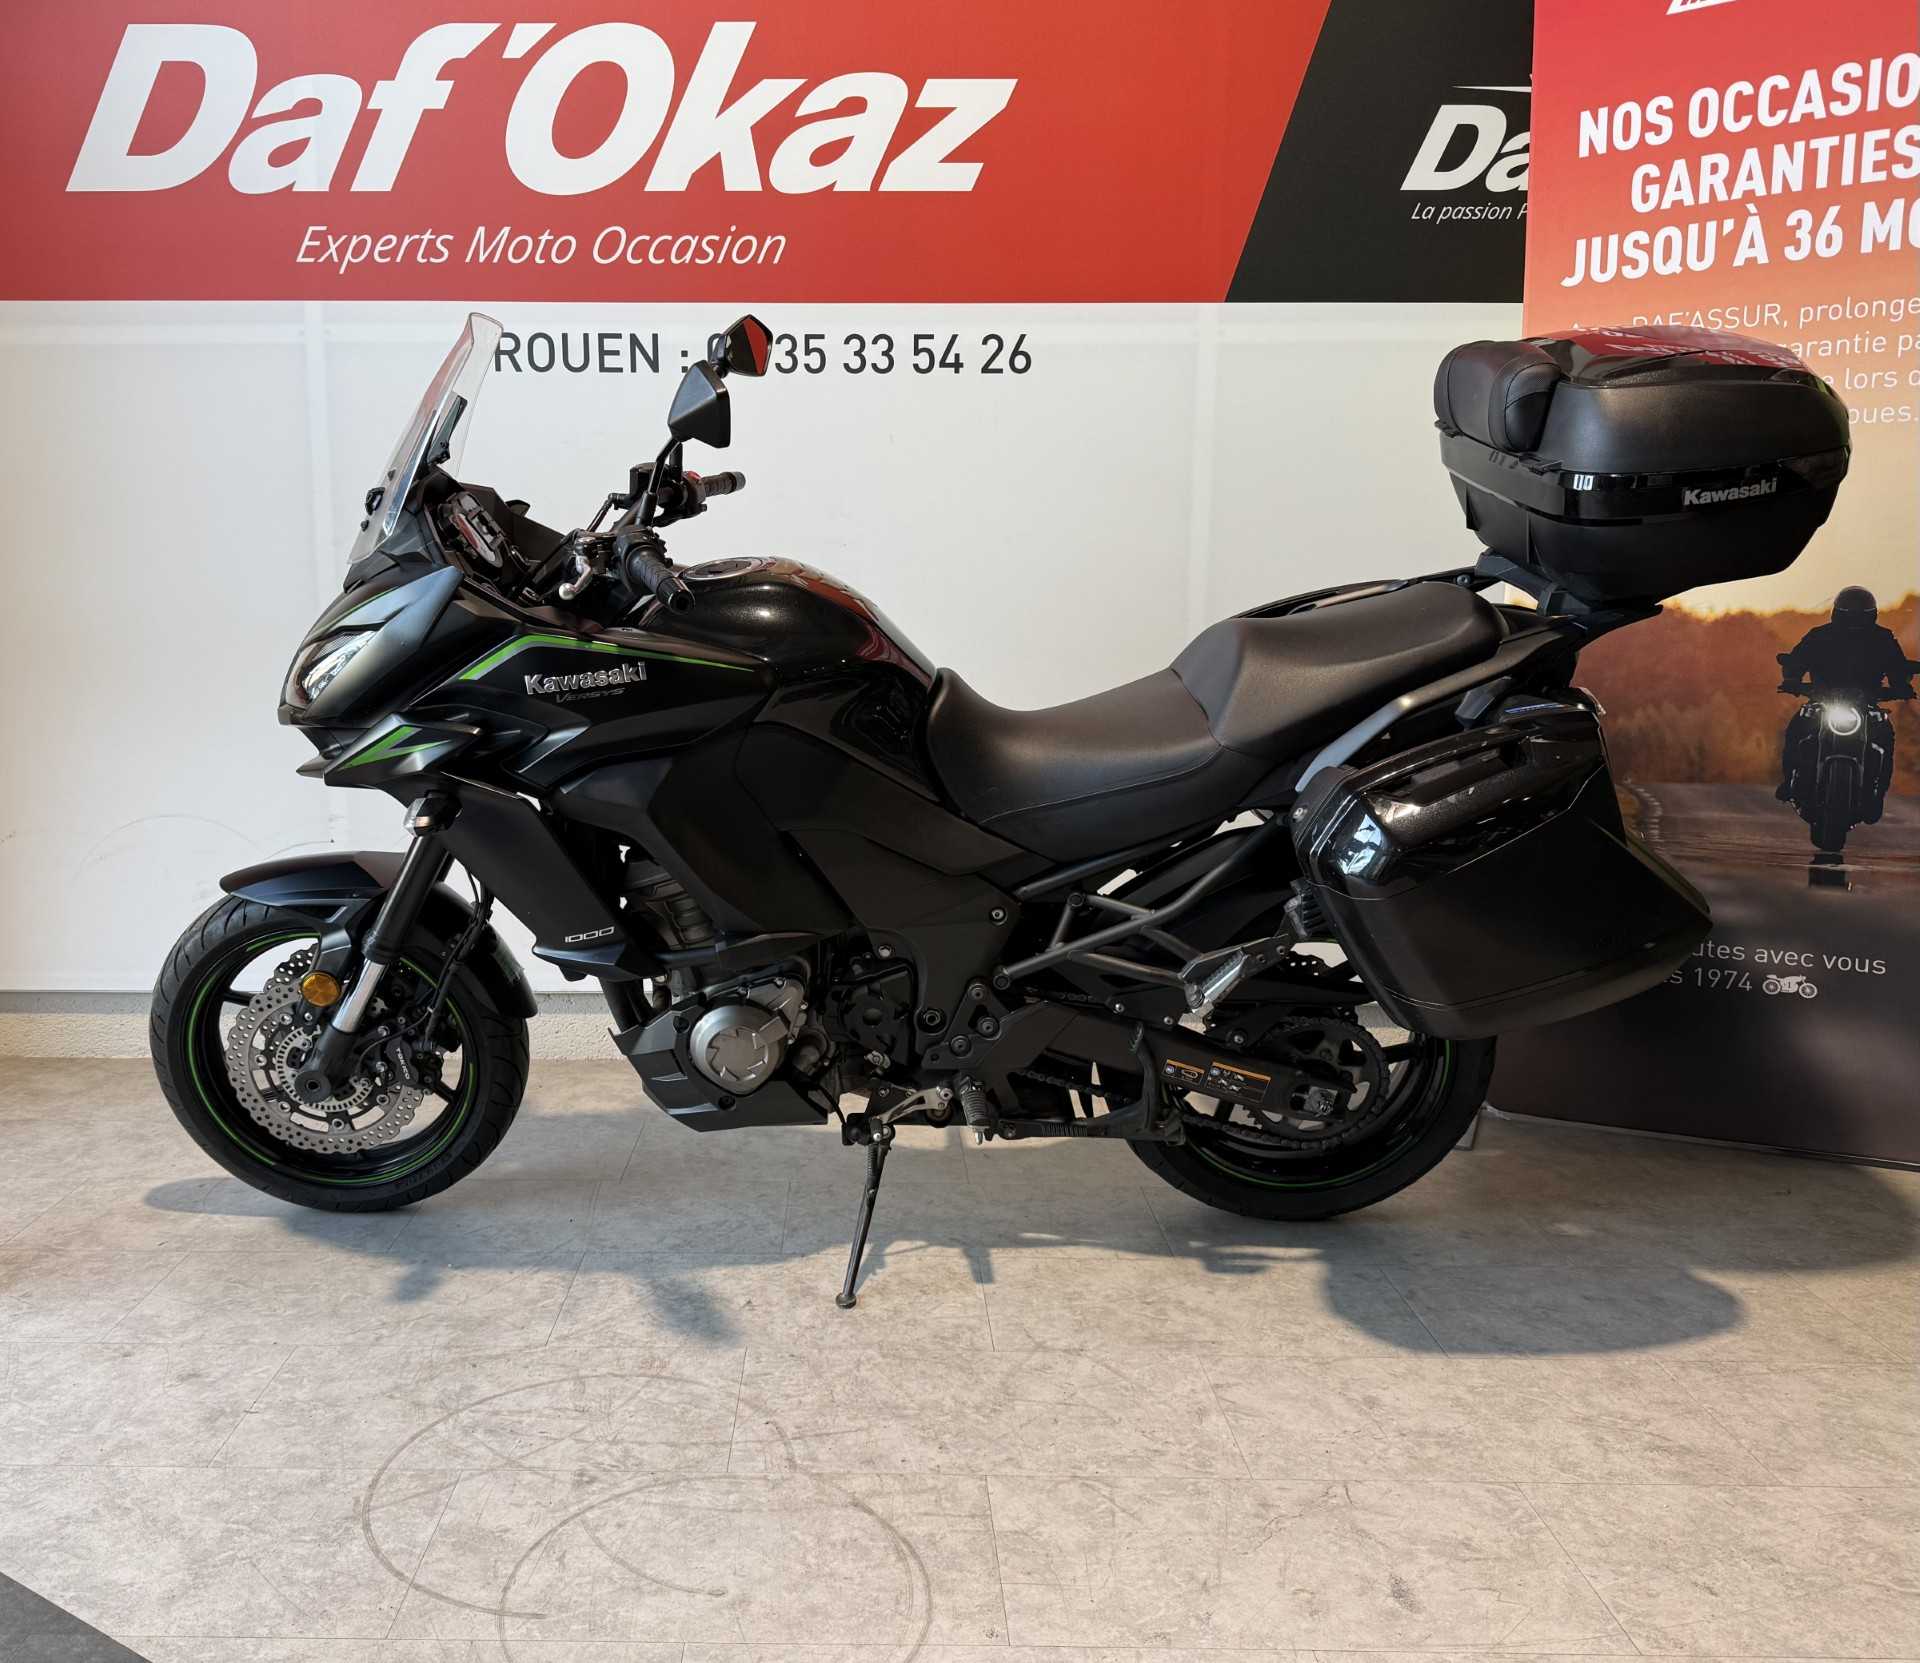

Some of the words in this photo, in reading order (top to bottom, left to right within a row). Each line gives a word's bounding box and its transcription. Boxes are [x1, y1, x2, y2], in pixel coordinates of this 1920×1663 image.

[1578, 96, 1674, 159] NOS
[1687, 52, 1920, 138] OCCASIO
[1631, 125, 1920, 213] GARANTIES
[1411, 202, 1436, 220] La
[1436, 202, 1513, 225] passion
[296, 226, 453, 274] Experts
[465, 226, 576, 265] Moto
[593, 225, 786, 265] Occasion
[1560, 203, 1770, 288] JUSQU'À
[1784, 205, 1843, 261] 36
[1799, 296, 1920, 330] prolonge
[495, 331, 660, 374] ROUEN
[774, 333, 828, 374] 35
[843, 333, 895, 374] 33
[912, 333, 965, 374] 54
[980, 333, 1033, 374] 26
[1844, 367, 1898, 390] lors
[1683, 477, 1777, 506] Kawasaki
[523, 661, 648, 695] Kawasaki
[564, 926, 615, 943] 1000
[1754, 948, 1815, 968] avec
[1822, 953, 1887, 975] vous
[1694, 967, 1753, 992] 1974
